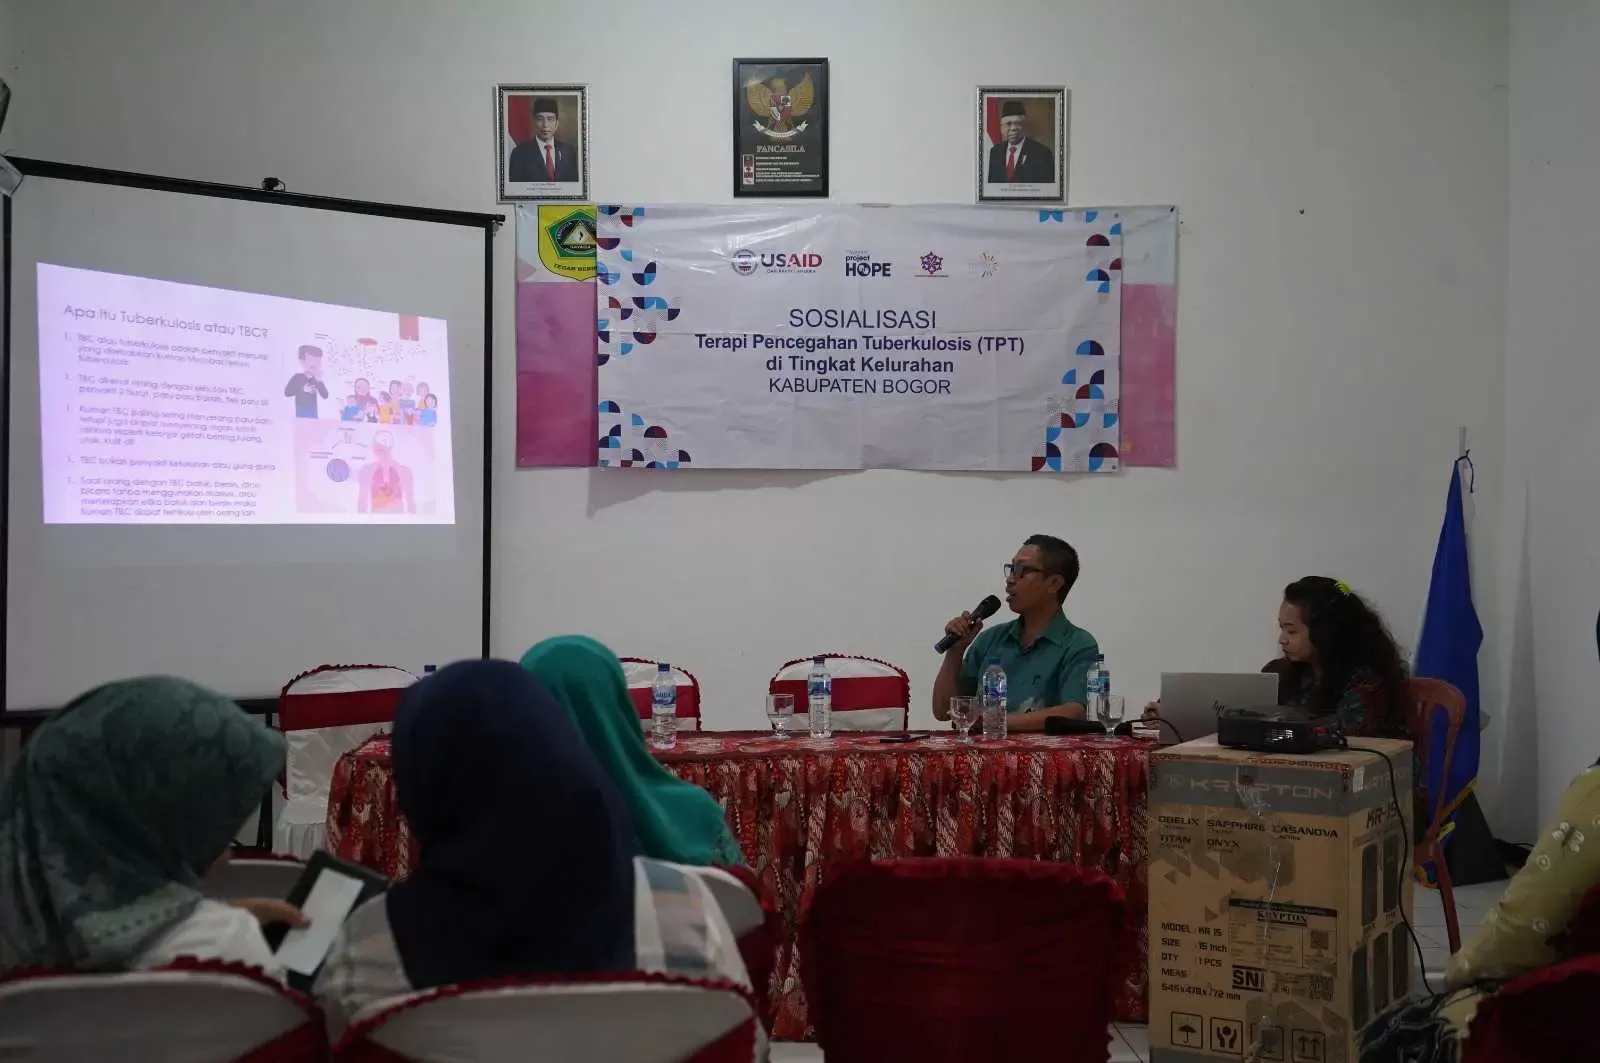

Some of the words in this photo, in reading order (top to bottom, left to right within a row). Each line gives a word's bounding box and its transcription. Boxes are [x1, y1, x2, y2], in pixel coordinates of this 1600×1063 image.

[756, 145, 806, 153] PANCASILA
[760, 253, 823, 269] USAID
[845, 254, 870, 263] project
[845, 262, 892, 278] HOPE
[63, 304, 95, 321] Apa
[120, 310, 200, 331] Tuberkulosis
[203, 322, 235, 335] atau
[238, 325, 268, 338] TBC?
[789, 309, 936, 329] SOSIALISASI
[695, 333, 747, 351] Terapi
[753, 334, 858, 351] Pencegahan
[862, 336, 972, 351] Tuberkulosis
[978, 336, 1025, 355] (TPT)
[766, 355, 782, 371] di
[788, 356, 856, 375] Tingkat
[861, 356, 954, 373] Kelurahan
[769, 378, 877, 393] KABUPATEN
[883, 378, 951, 394] BOGOR
[1159, 816, 1200, 826] OBELIX
[1207, 820, 1265, 832] SAPPHIRE
[1272, 824, 1339, 838] CASANOVA
[1160, 834, 1191, 844] TITAN
[1207, 838, 1240, 848] ONYX
[1161, 922, 1191, 933] MODEL
[1161, 937, 1180, 947] SIZE
[1161, 952, 1180, 961] QTY
[1204, 958, 1222, 968] PCS
